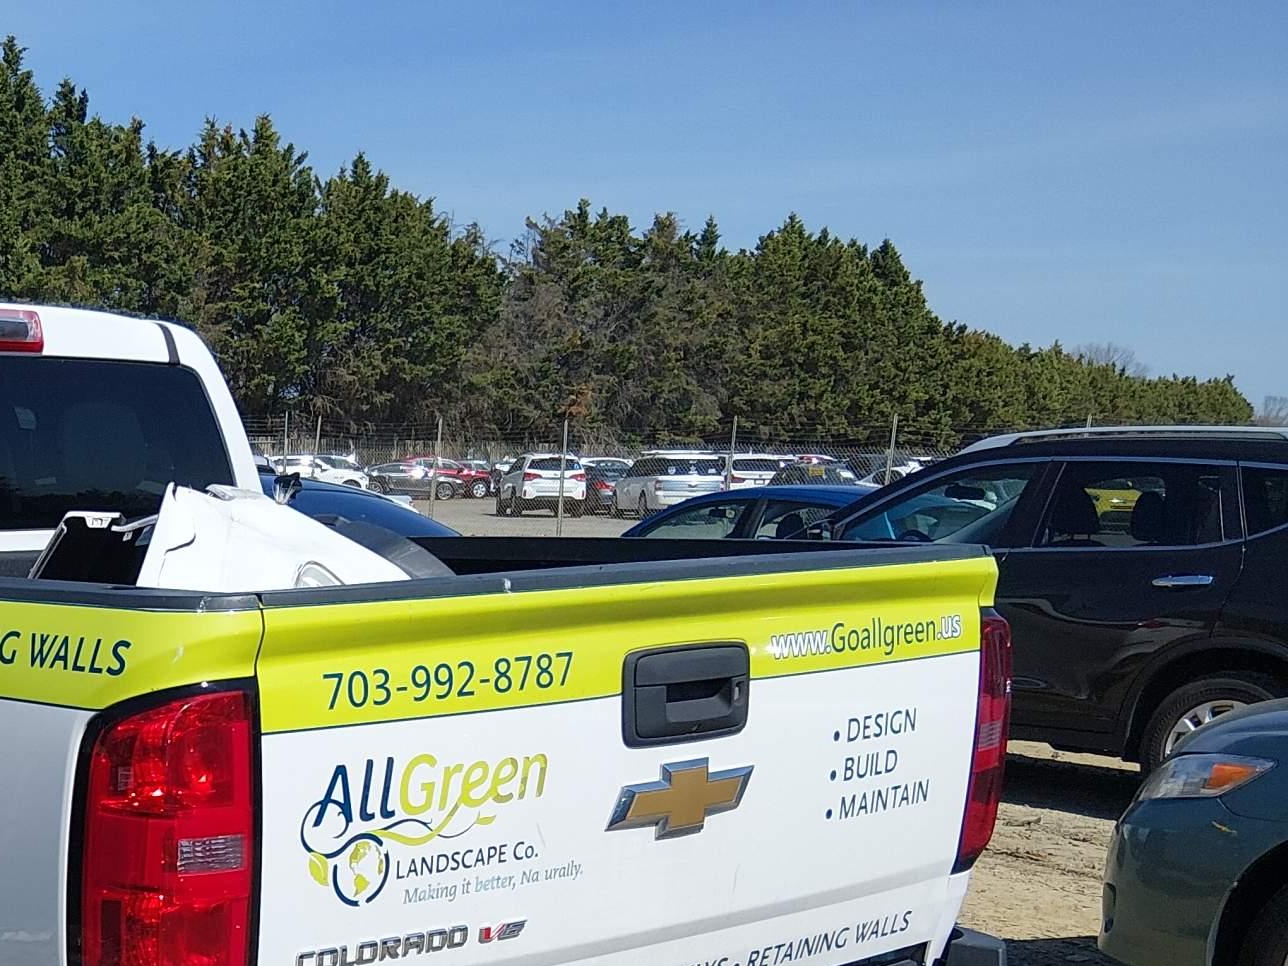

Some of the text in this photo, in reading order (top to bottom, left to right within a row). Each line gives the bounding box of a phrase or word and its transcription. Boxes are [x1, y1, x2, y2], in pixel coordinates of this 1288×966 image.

[29, 632, 132, 676] WALLS
[771, 615, 961, 659] www.Goallgreen.us
[322, 651, 574, 711] 703-992-8787
[846, 708, 917, 743] DESIGN
[843, 750, 898, 781] BUILD
[309, 753, 548, 828] AllGreen
[838, 779, 930, 820] MAINTAIN
[396, 841, 539, 880] LANDSCAPE Co.
[403, 883, 458, 905] Making
[461, 878, 472, 895] it
[474, 874, 516, 893] better,
[478, 918, 529, 944] V6
[855, 910, 913, 945] WALLS
